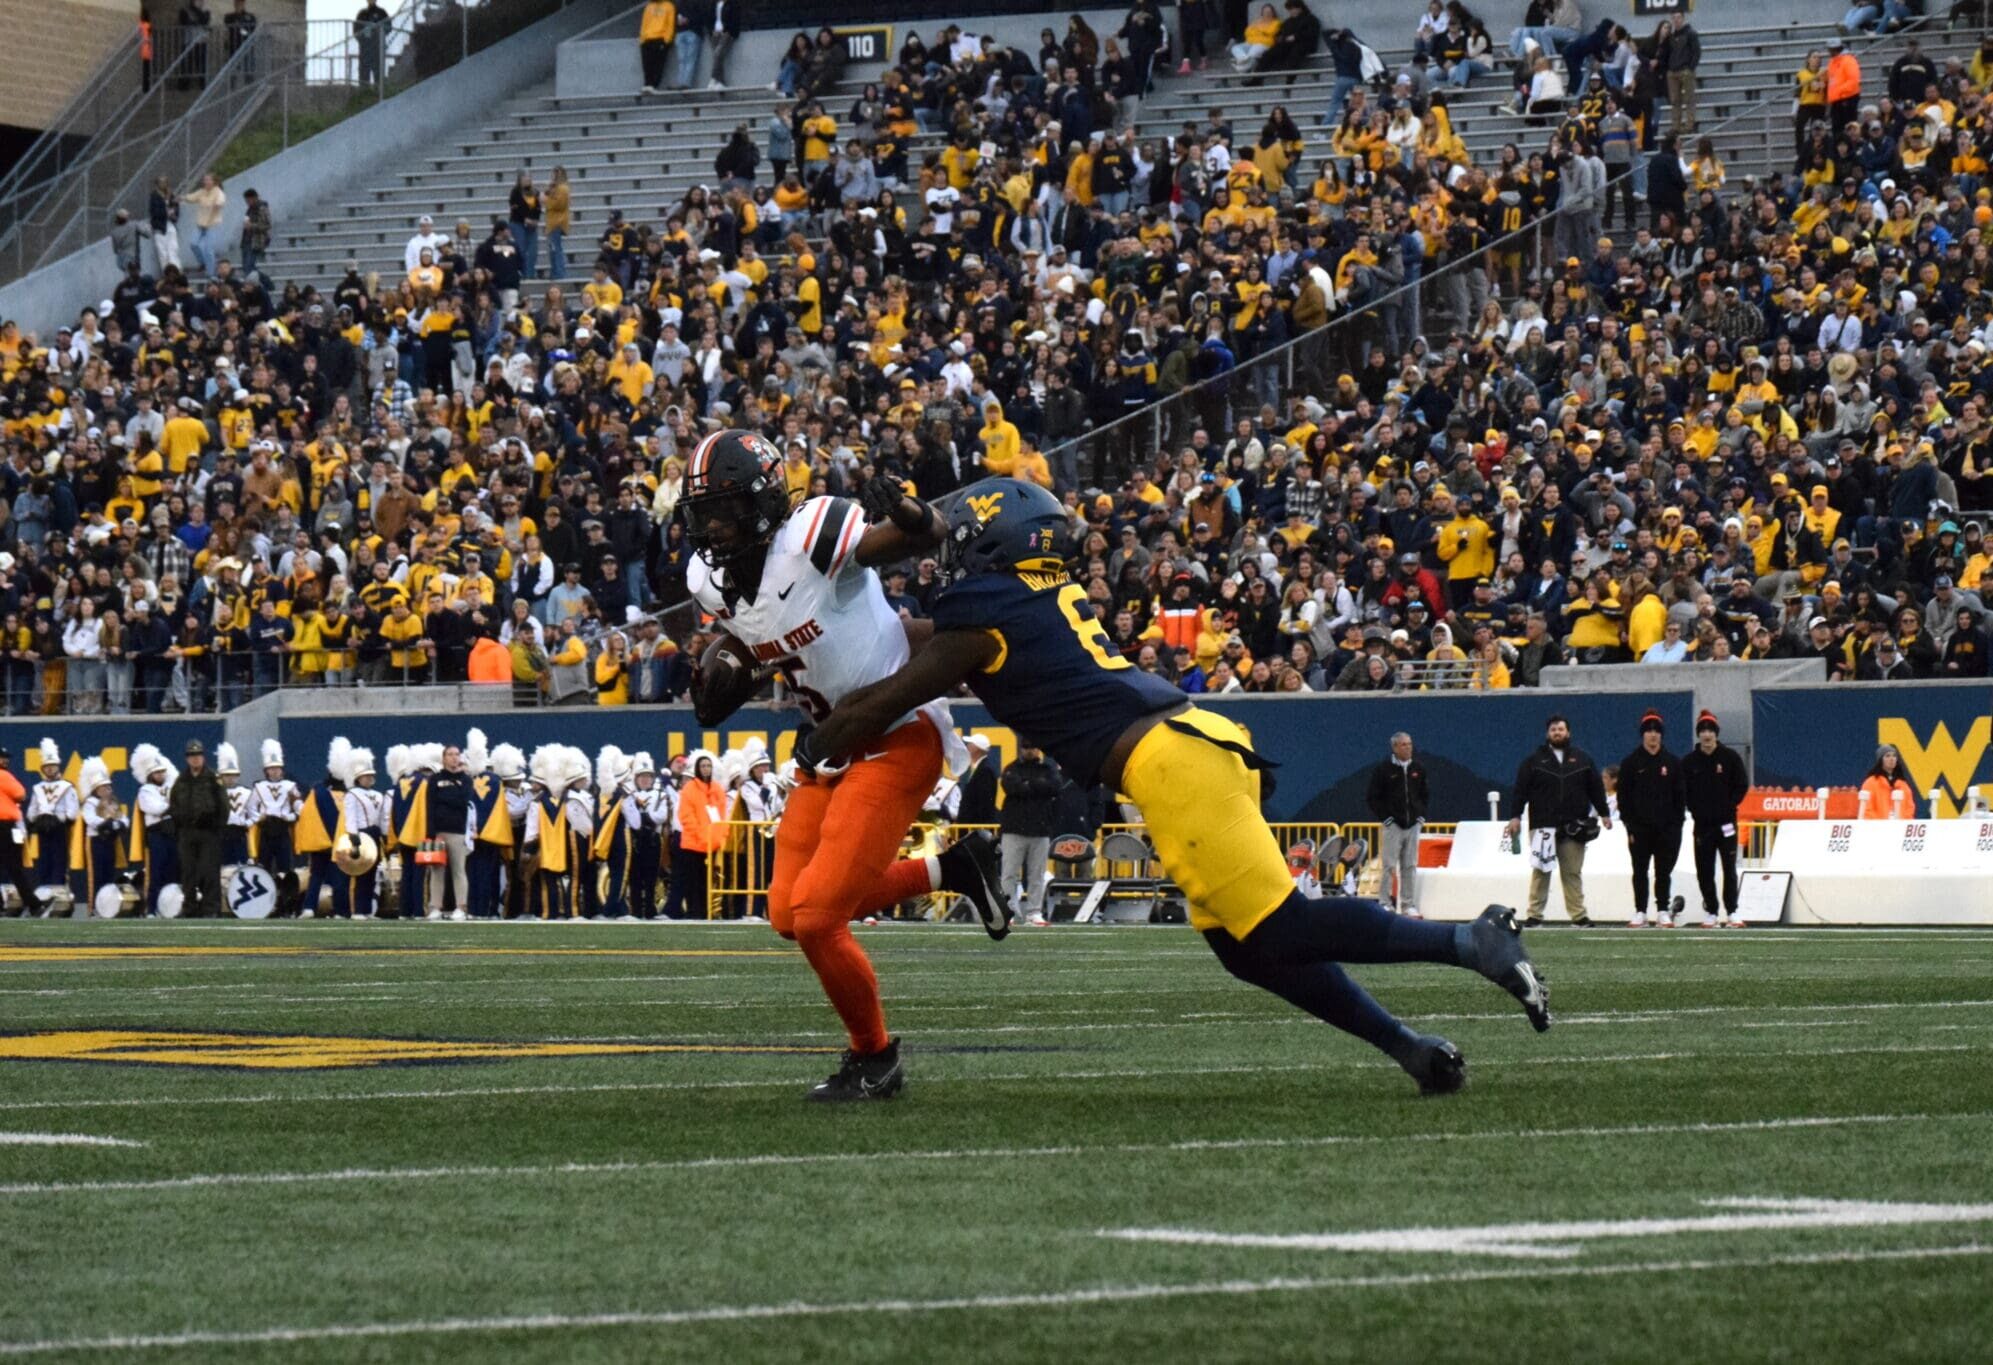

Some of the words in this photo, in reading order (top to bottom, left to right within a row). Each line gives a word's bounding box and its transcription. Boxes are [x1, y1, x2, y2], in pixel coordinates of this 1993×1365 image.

[848, 35, 874, 58] 110
[783, 618, 824, 651] STATE
[1763, 797, 1822, 811] GATORAD
[1831, 825, 1852, 839] BIG
[1905, 824, 1927, 838] BIG
[1980, 823, 1993, 837] BI
